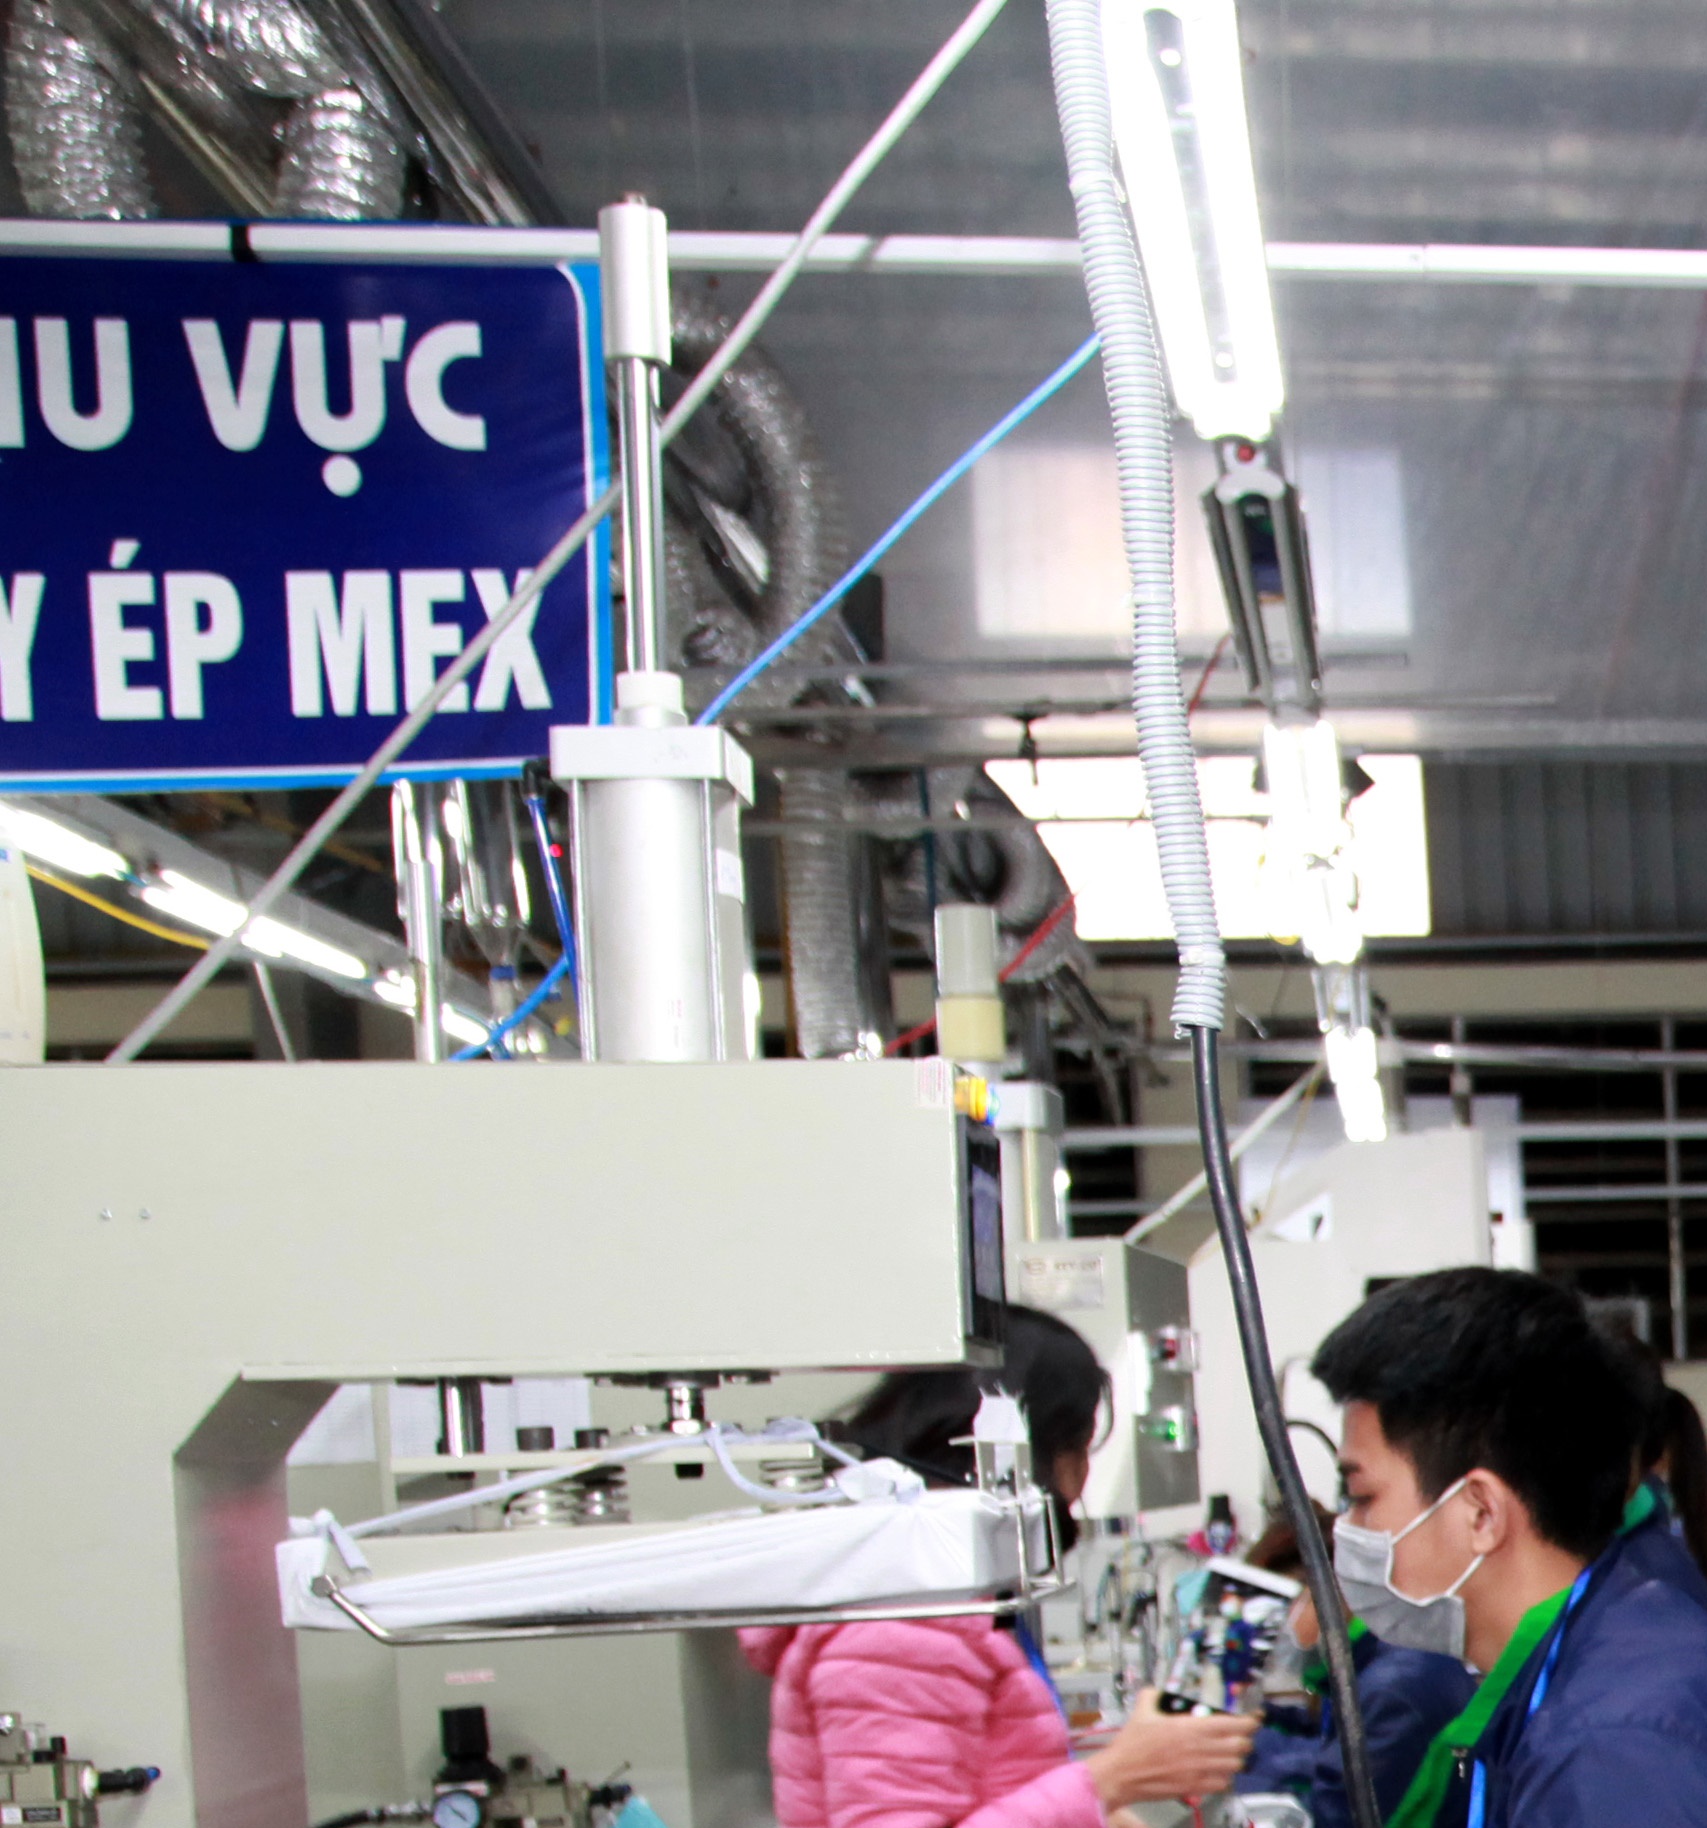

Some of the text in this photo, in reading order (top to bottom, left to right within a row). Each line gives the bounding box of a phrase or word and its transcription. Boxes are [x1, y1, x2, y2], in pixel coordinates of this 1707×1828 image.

[182, 314, 488, 498] VỰC
[87, 538, 243, 720] ÉP
[285, 567, 553, 718] MEX
